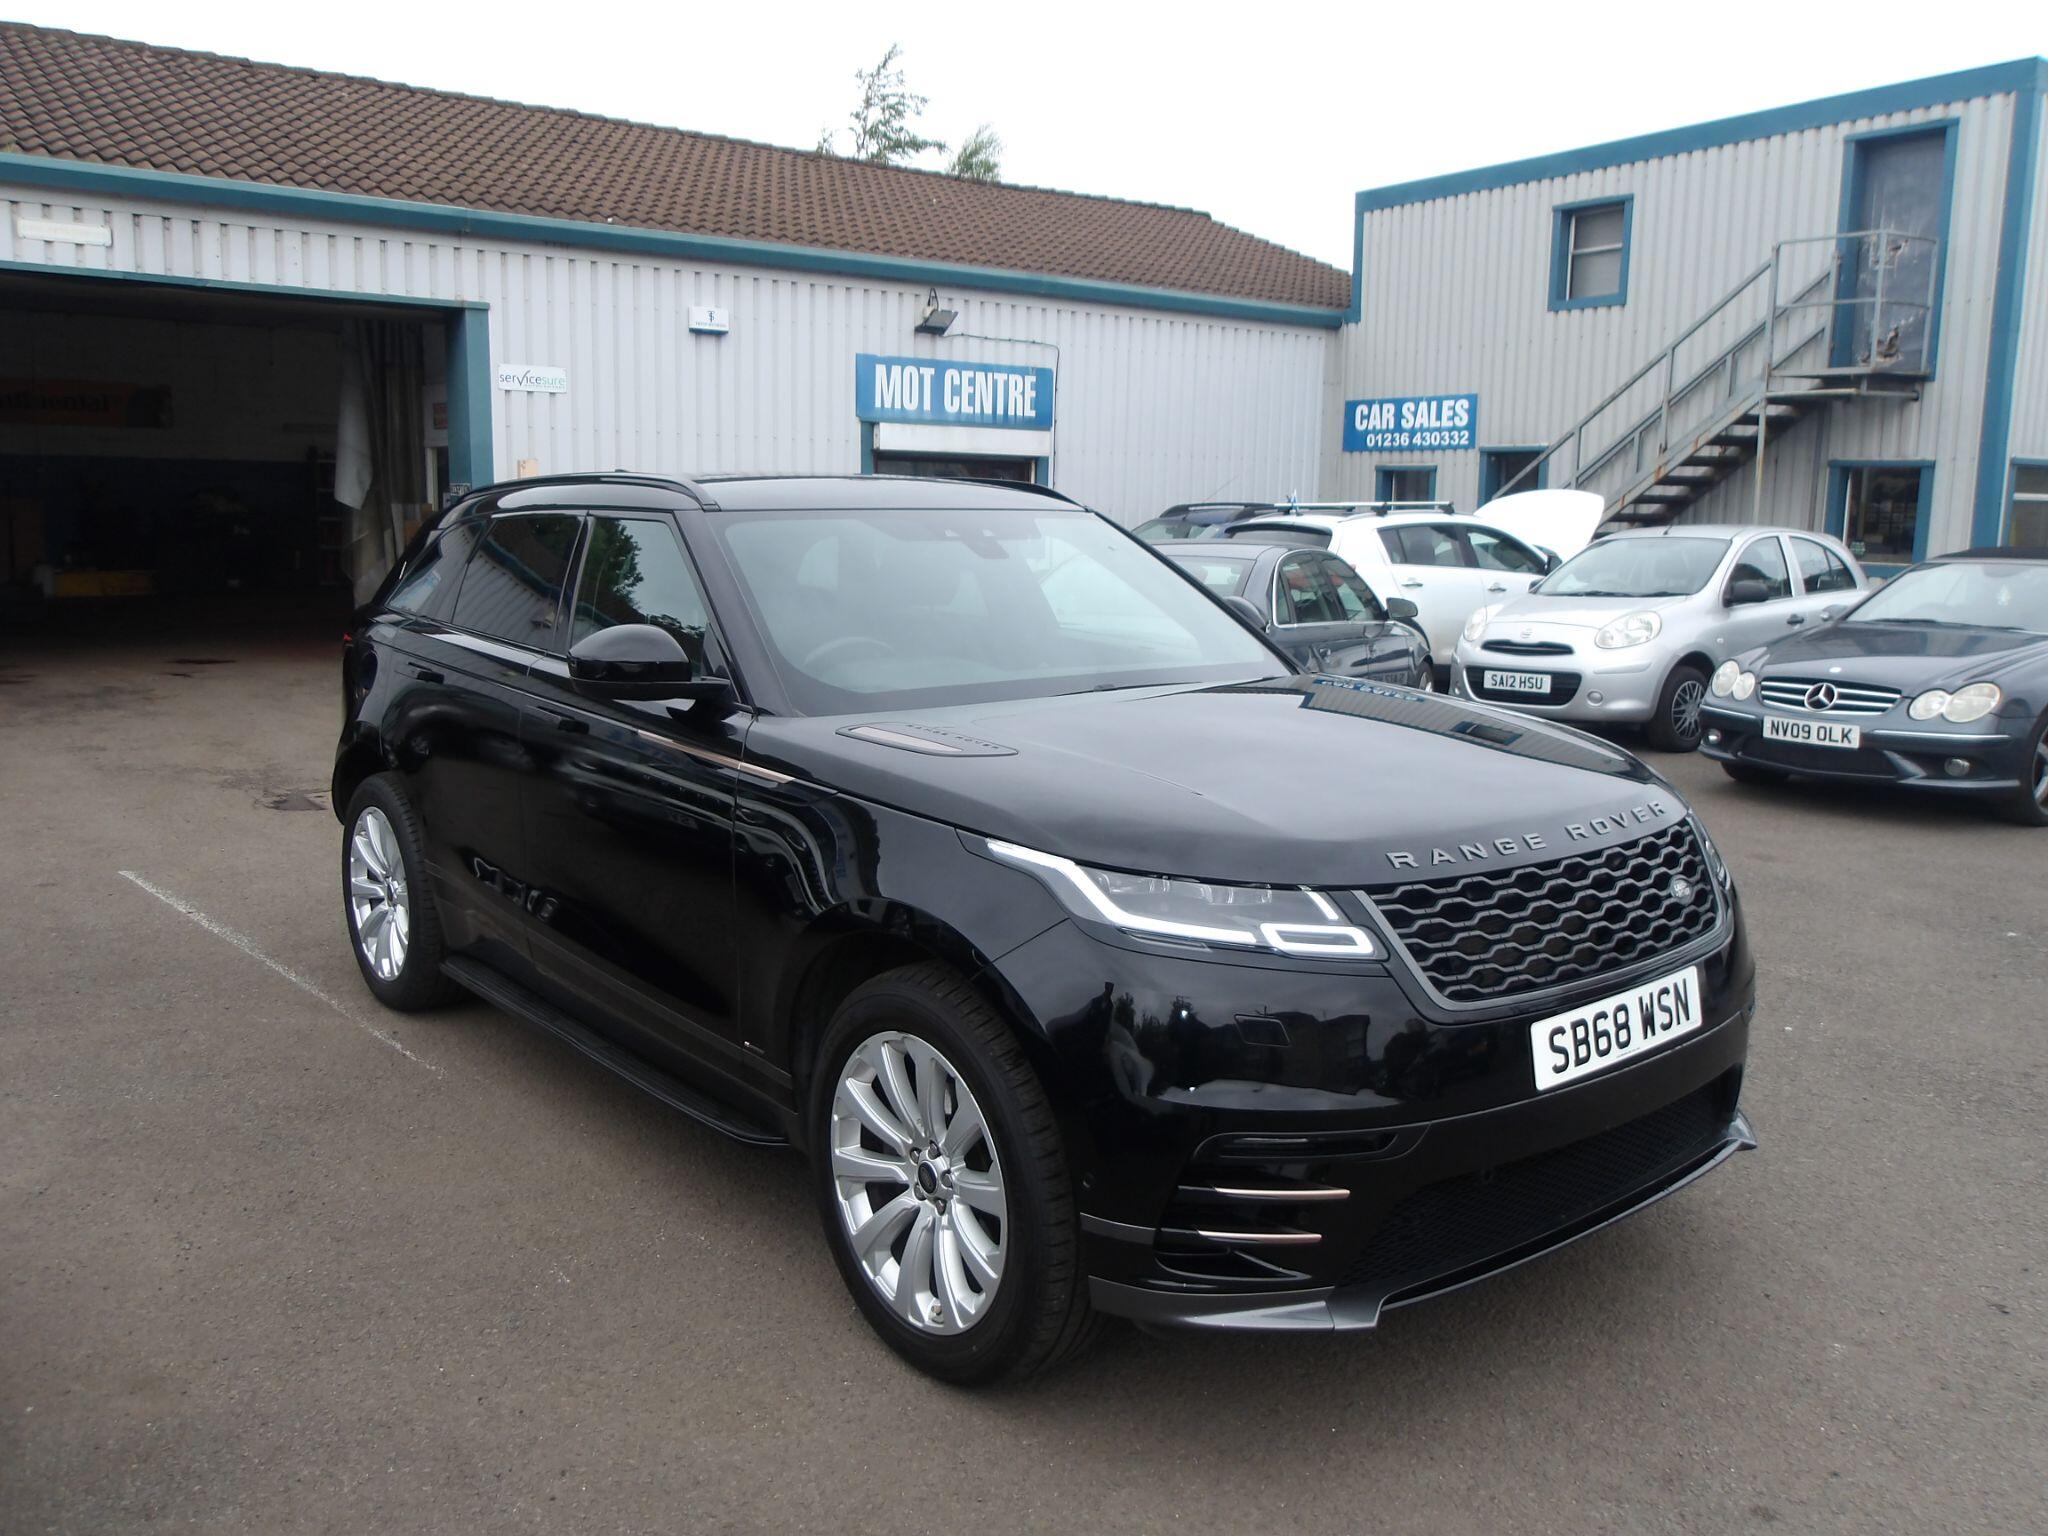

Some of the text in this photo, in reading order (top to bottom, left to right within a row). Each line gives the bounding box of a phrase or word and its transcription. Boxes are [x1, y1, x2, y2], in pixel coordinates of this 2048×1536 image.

[875, 364, 1037, 418] MOT CENTRE
[1354, 398, 1470, 431] CAR SALES
[1366, 430, 1470, 447] 01236 430332
[1491, 674, 1544, 690] SA12 HSU
[1770, 719, 1853, 744] NV09 OLK
[1385, 800, 1667, 869] RANGE ROVER
[1548, 978, 1691, 1075] SB68 WSN
